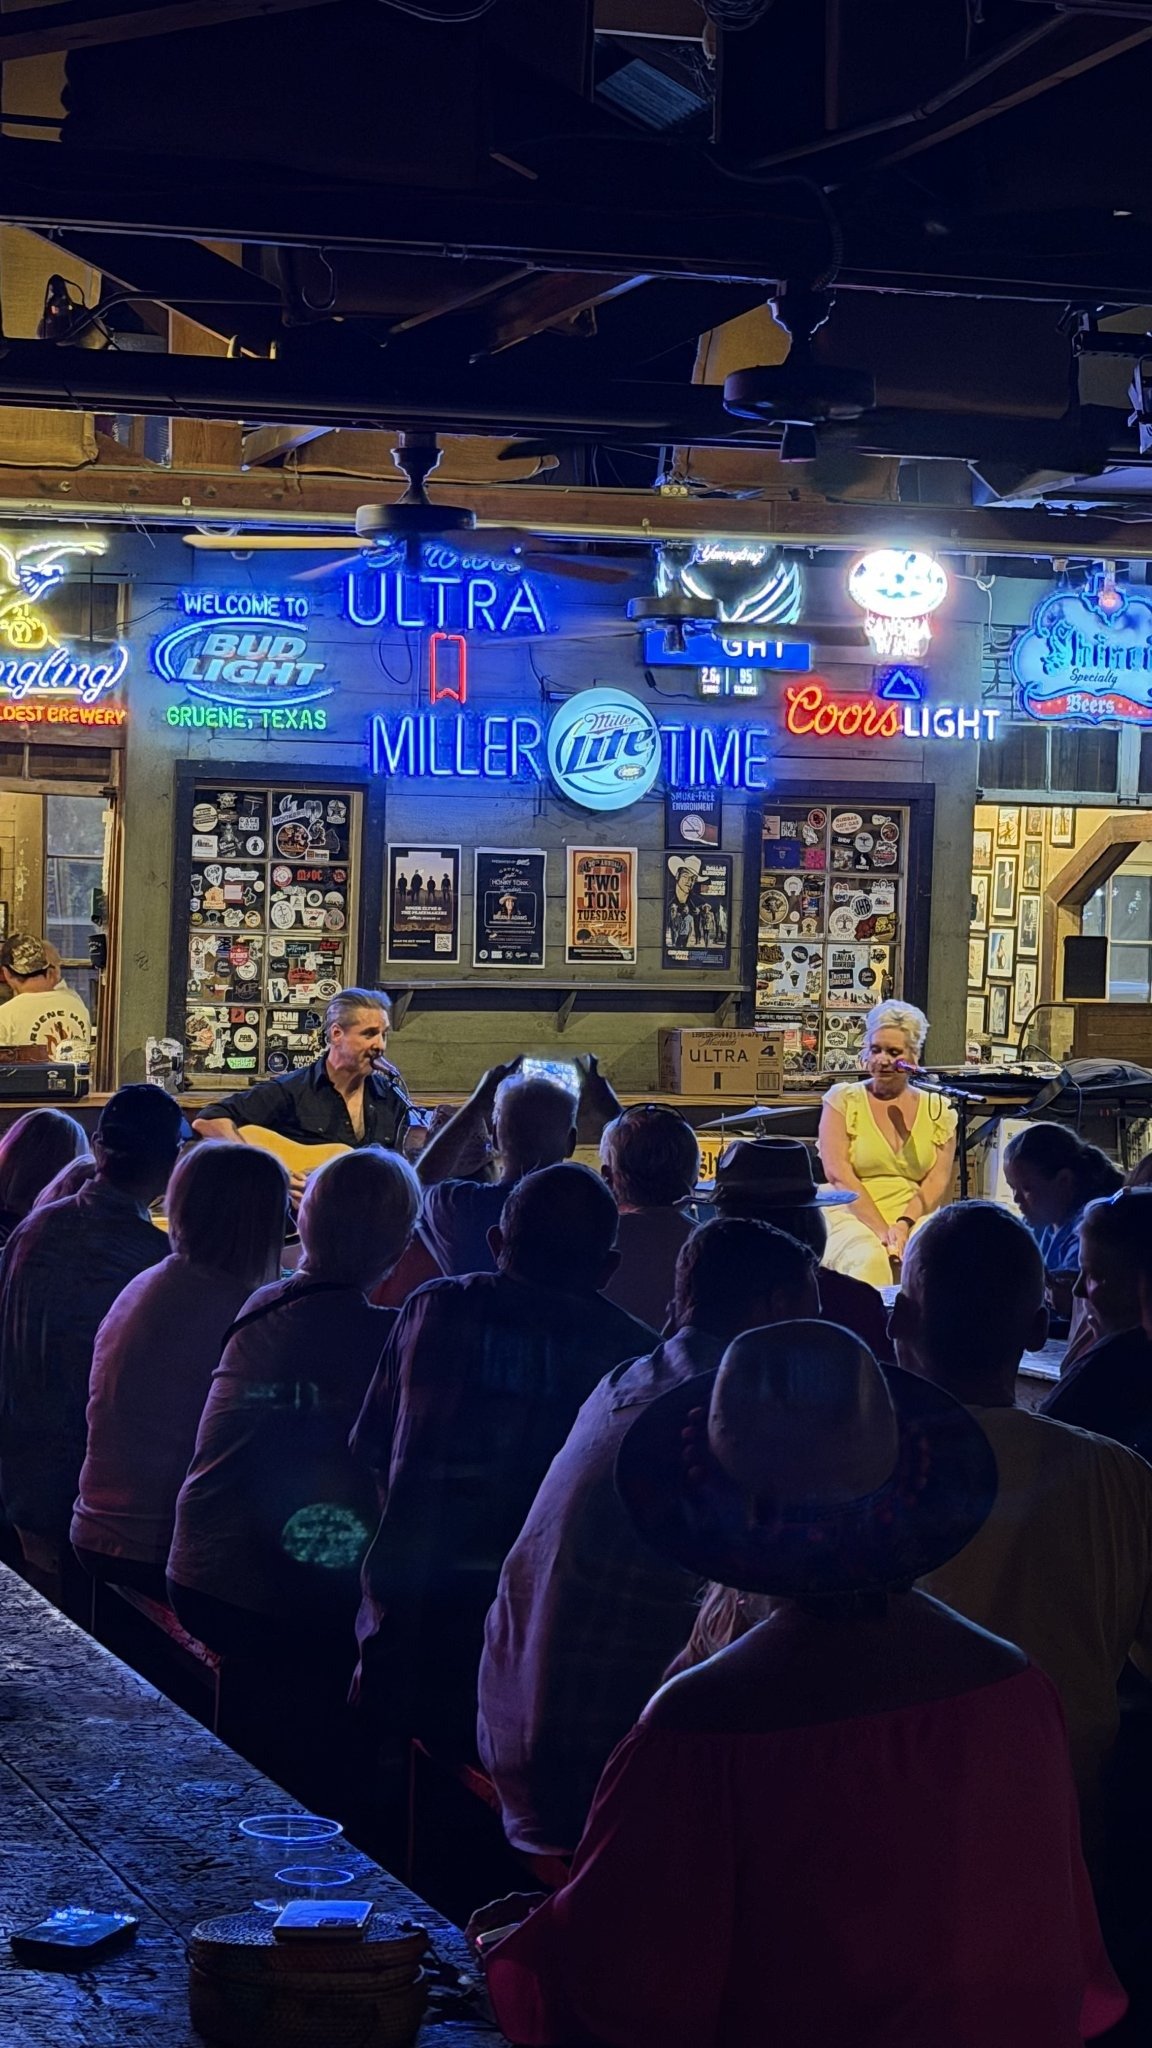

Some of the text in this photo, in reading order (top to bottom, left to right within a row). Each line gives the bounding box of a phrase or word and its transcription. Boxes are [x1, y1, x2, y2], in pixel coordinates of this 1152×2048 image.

[184, 593, 308, 616] WELCOME TO
[348, 572, 546, 632] ULTRA
[201, 633, 307, 661] BUD
[178, 657, 326, 686] LIGHT
[739, 668, 753, 684] 95
[1069, 667, 1119, 688] Specialty
[786, 685, 1001, 741] Coors LIGHT
[1065, 693, 1116, 715] Beers
[47, 707, 127, 725] BREWERY
[166, 705, 327, 730] GRUENE, TEXAS
[584, 712, 641, 733] Miller
[372, 714, 769, 789] MILLER TIME
[562, 728, 656, 775] Lite
[671, 802, 714, 811] ENVIRONMENT
[584, 874, 620, 892] TWO
[584, 891, 620, 909] TON
[577, 909, 627, 921] TUESDAYS
[30, 1010, 87, 1045] RUENE HAL
[689, 1048, 749, 1063] ULTRA
[760, 1045, 776, 1057] 4
